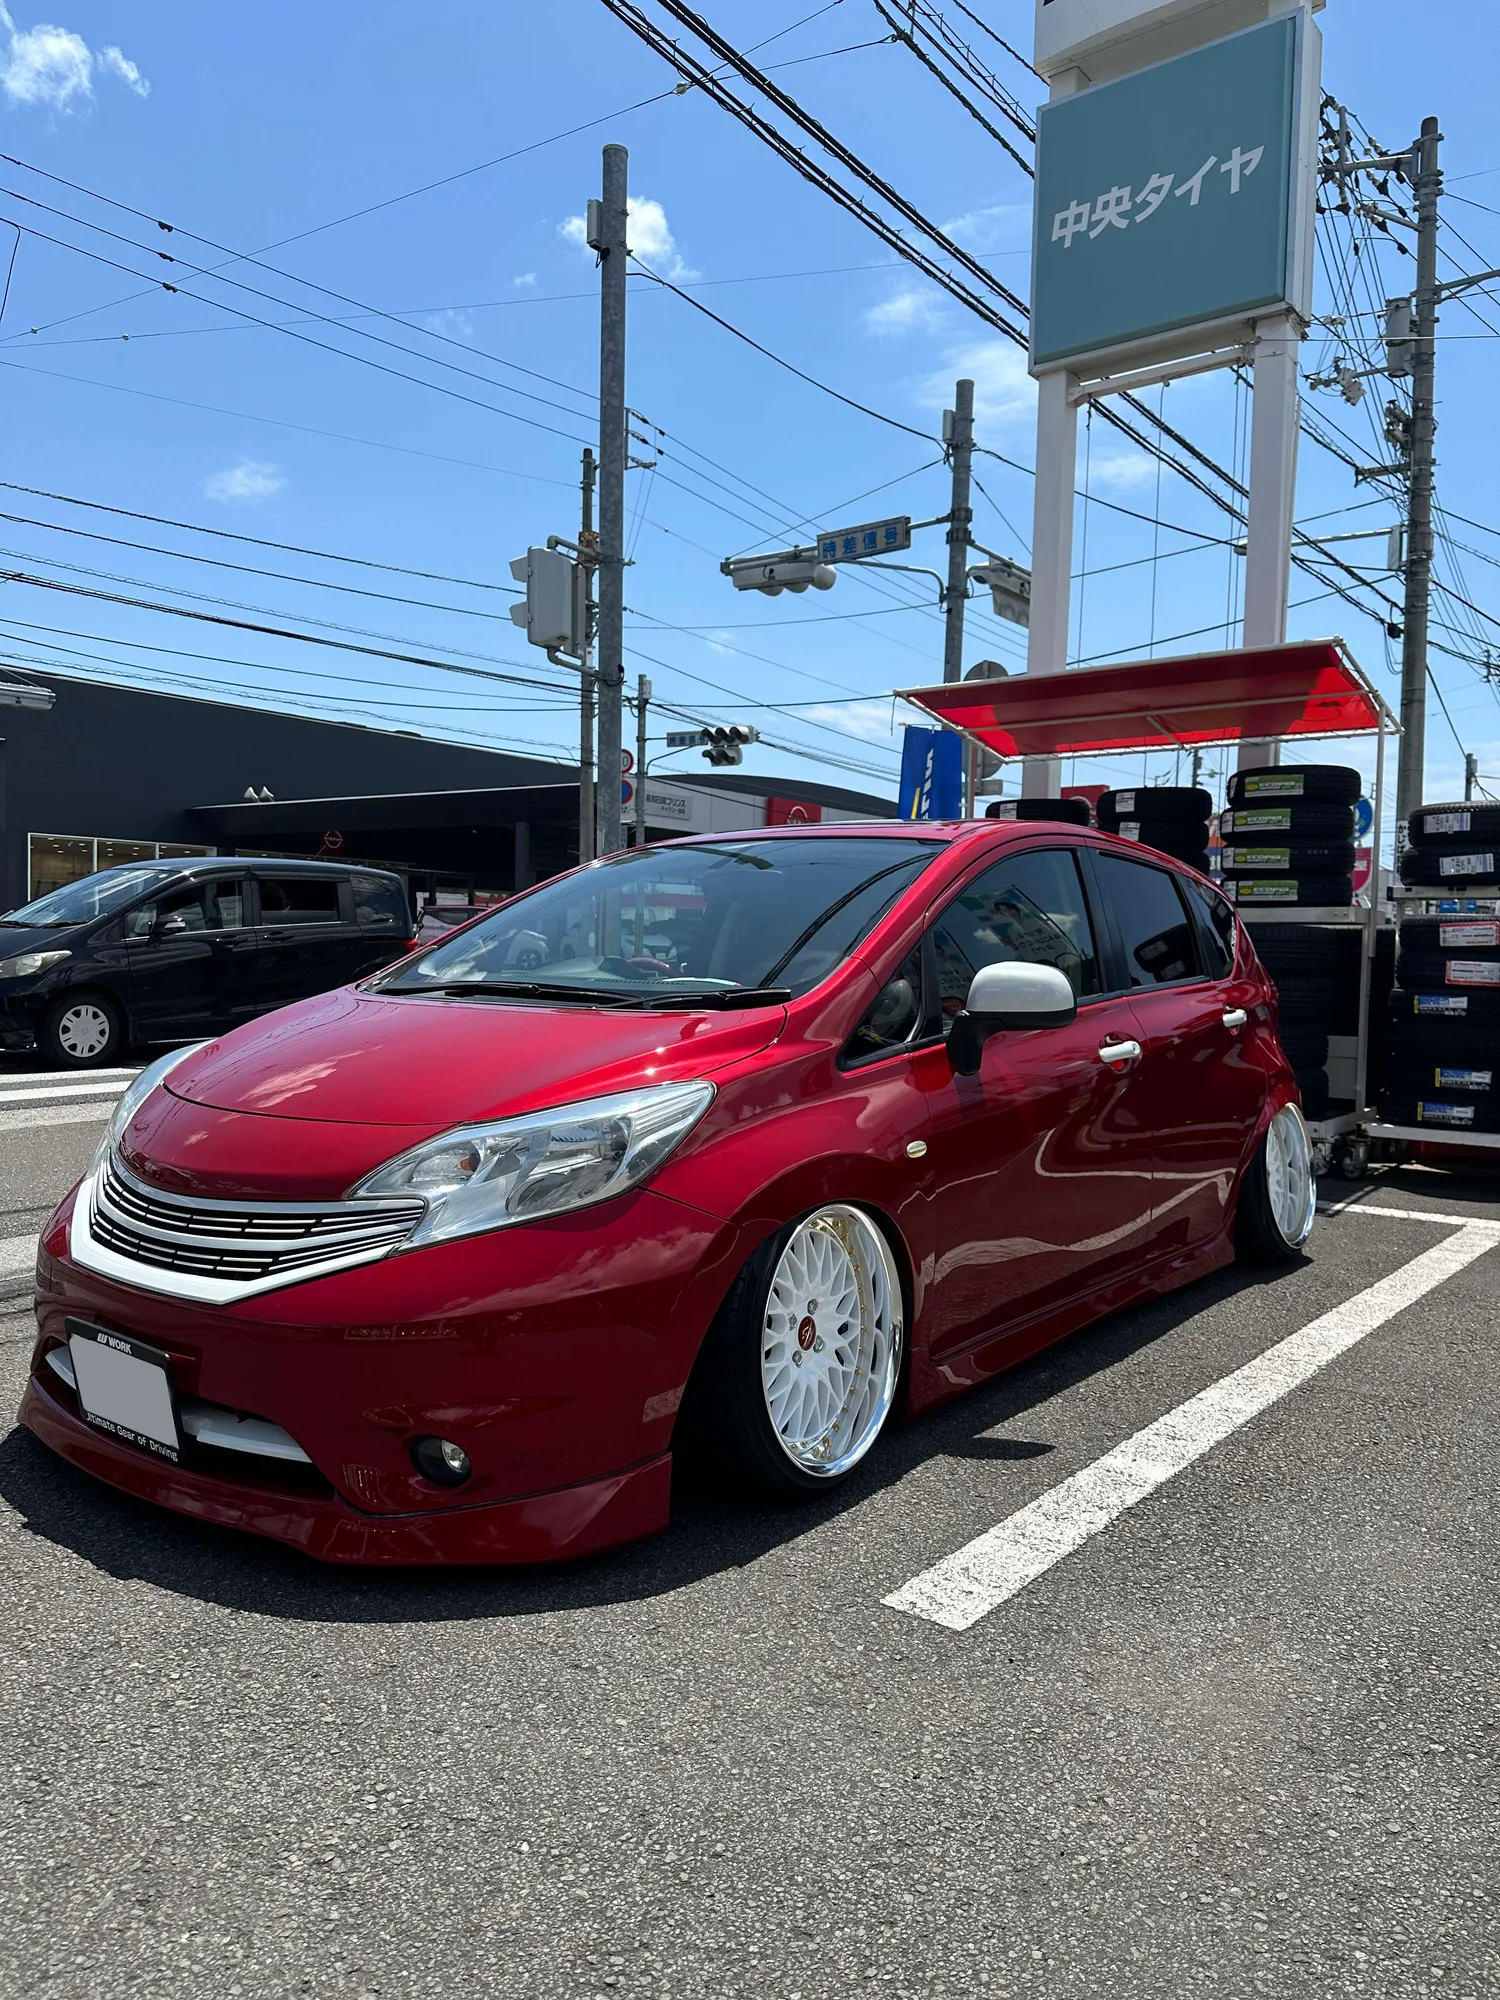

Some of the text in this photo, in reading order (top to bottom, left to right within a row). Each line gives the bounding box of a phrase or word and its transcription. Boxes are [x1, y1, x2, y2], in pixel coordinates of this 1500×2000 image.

[1051, 145, 1265, 248] 中央タイヤ
[823, 527, 898, 558] 時差信号
[108, 1336, 132, 1354] WORK
[117, 1425, 135, 1441] Gear
[137, 1435, 147, 1447] of
[149, 1440, 178, 1462] Driving
